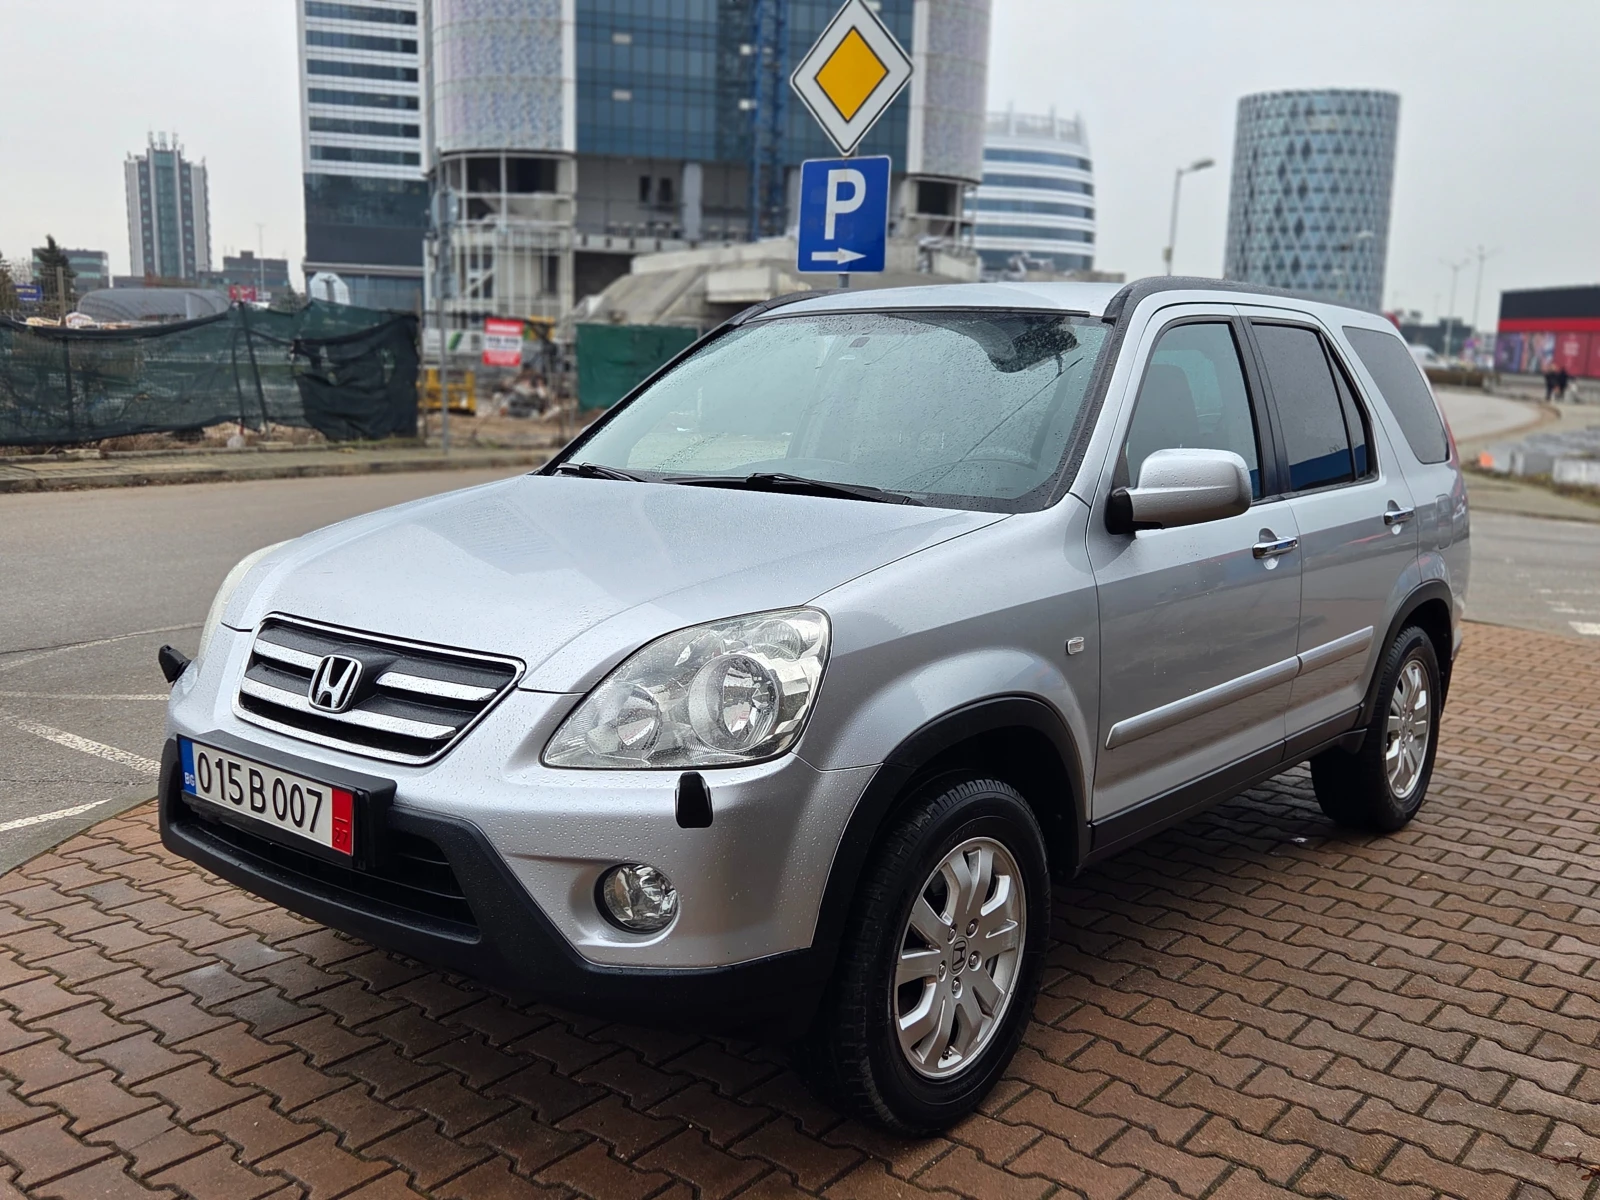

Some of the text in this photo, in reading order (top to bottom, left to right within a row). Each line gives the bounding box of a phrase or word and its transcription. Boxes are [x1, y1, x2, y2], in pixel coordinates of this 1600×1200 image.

[824, 169, 866, 240] P
[184, 771, 196, 787] BG
[335, 827, 348, 845] 27
